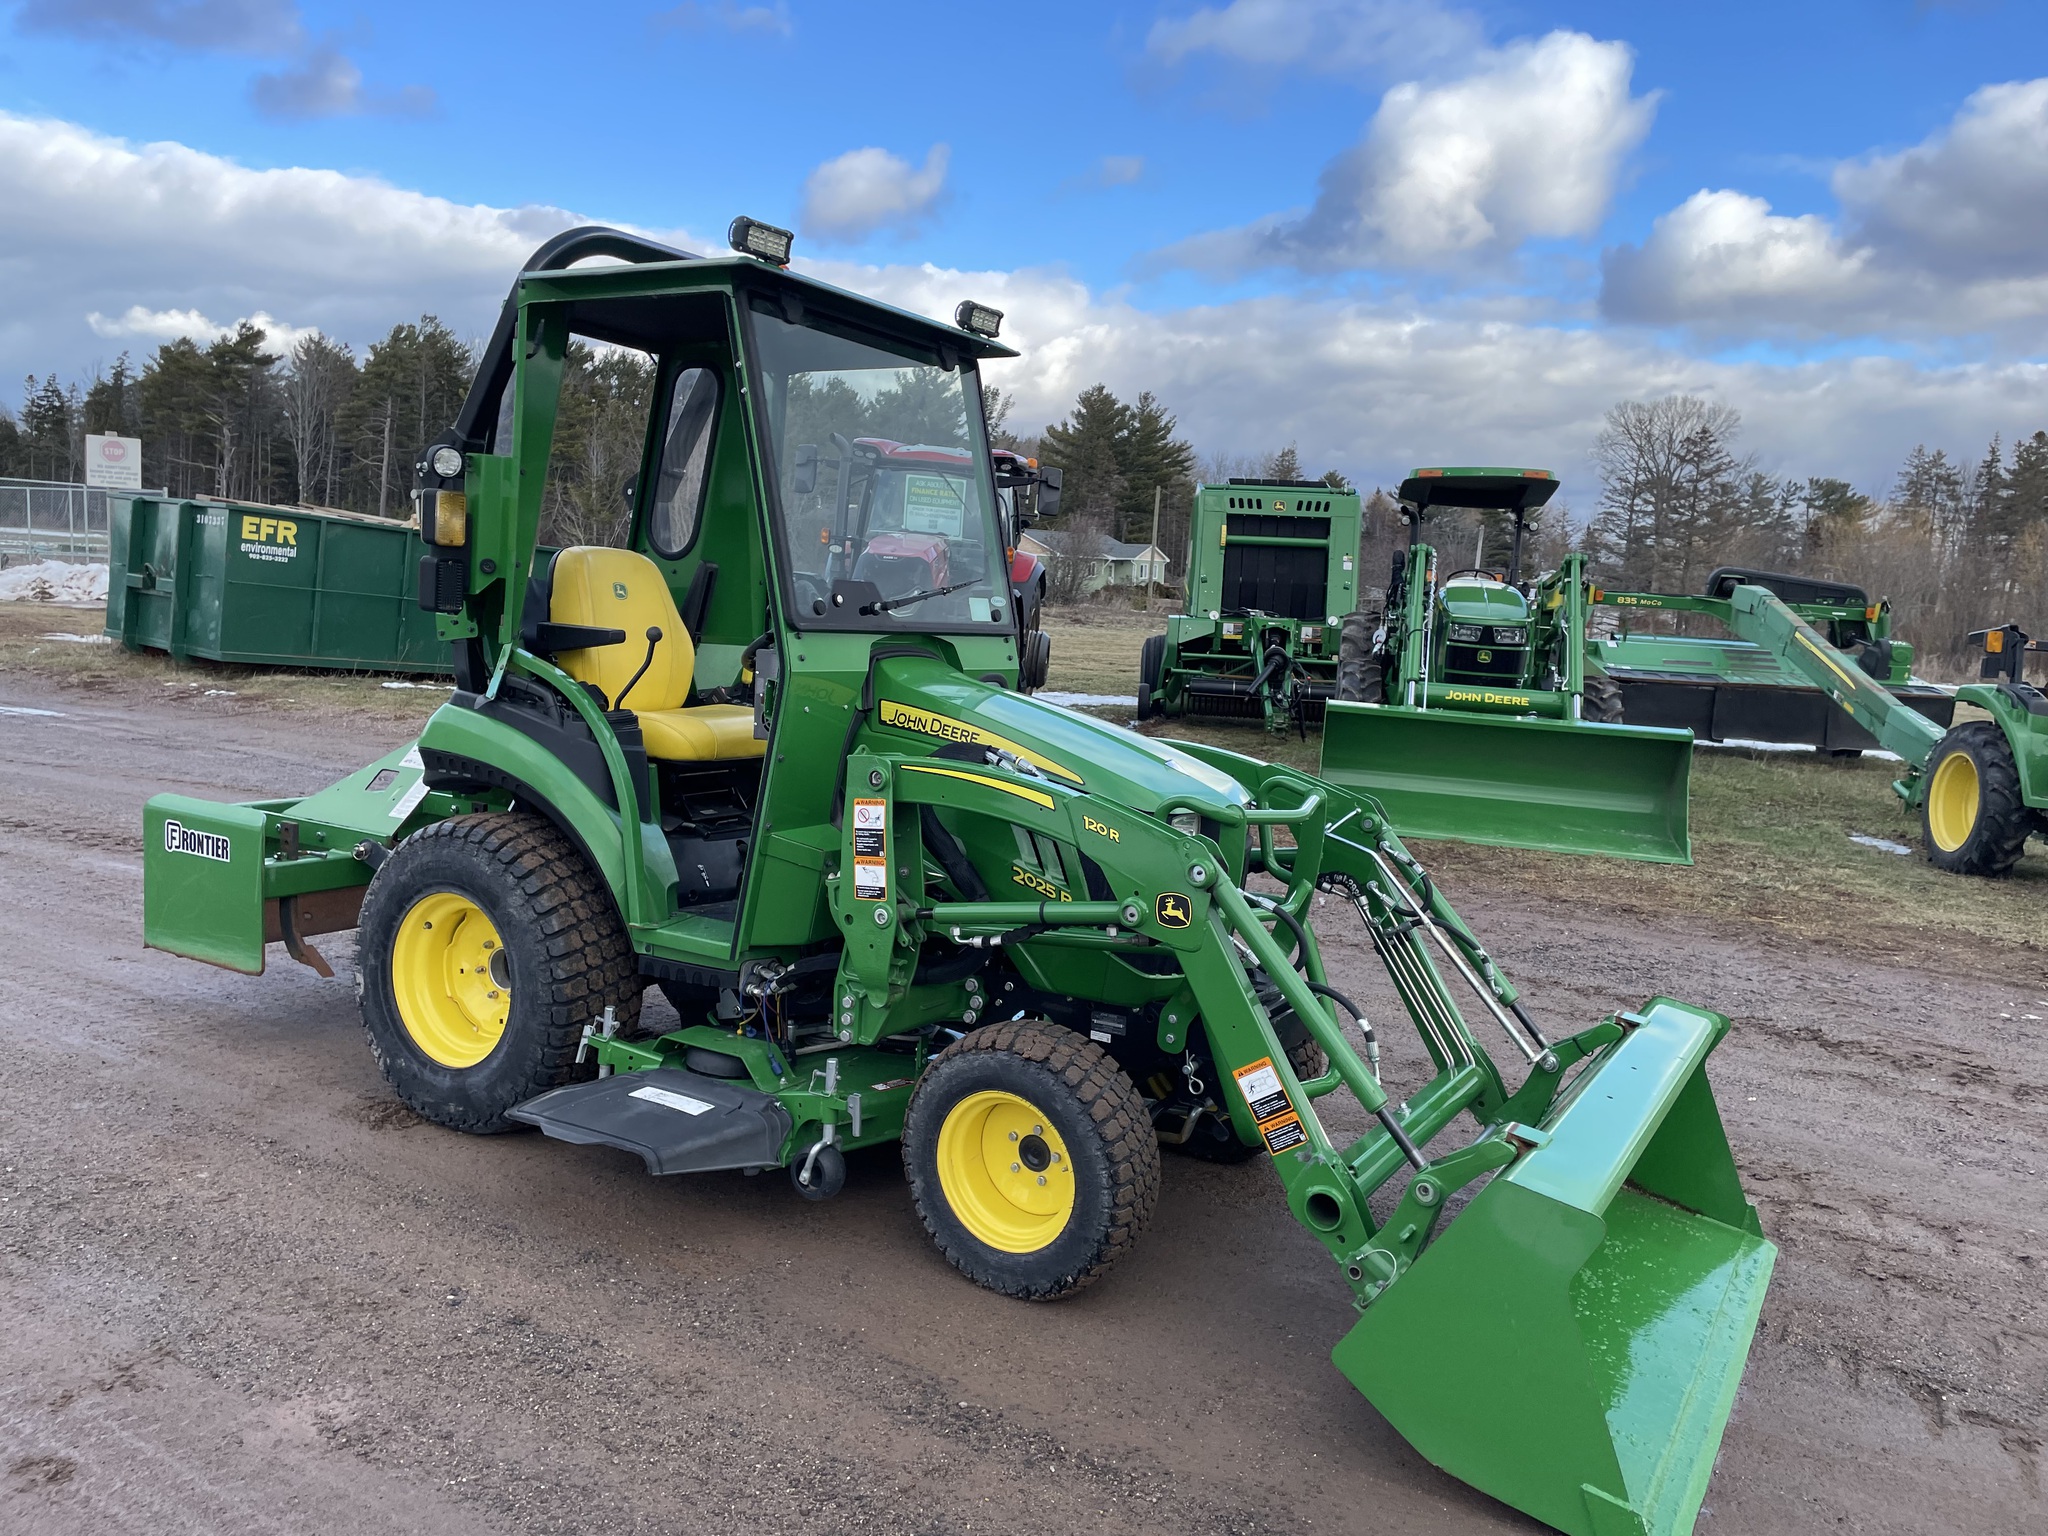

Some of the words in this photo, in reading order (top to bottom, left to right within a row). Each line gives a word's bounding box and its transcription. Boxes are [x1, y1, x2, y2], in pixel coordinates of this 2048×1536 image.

[104, 447, 124, 456] STOP
[911, 487, 938, 496] FINANCE
[241, 515, 298, 546] EFR
[240, 542, 297, 558] environmental
[1617, 596, 1638, 605] 835
[1445, 690, 1482, 702] JOHN
[1484, 693, 1530, 706] DEERE
[889, 709, 927, 731] JOHN
[930, 718, 980, 743] DEERE
[1083, 815, 1108, 836] 120
[1109, 828, 1120, 843] R
[166, 820, 229, 860] FRONTIER
[1012, 866, 1057, 899] 2025
[1243, 1061, 1267, 1074] WARNING
[1270, 1116, 1295, 1129] WARNING
